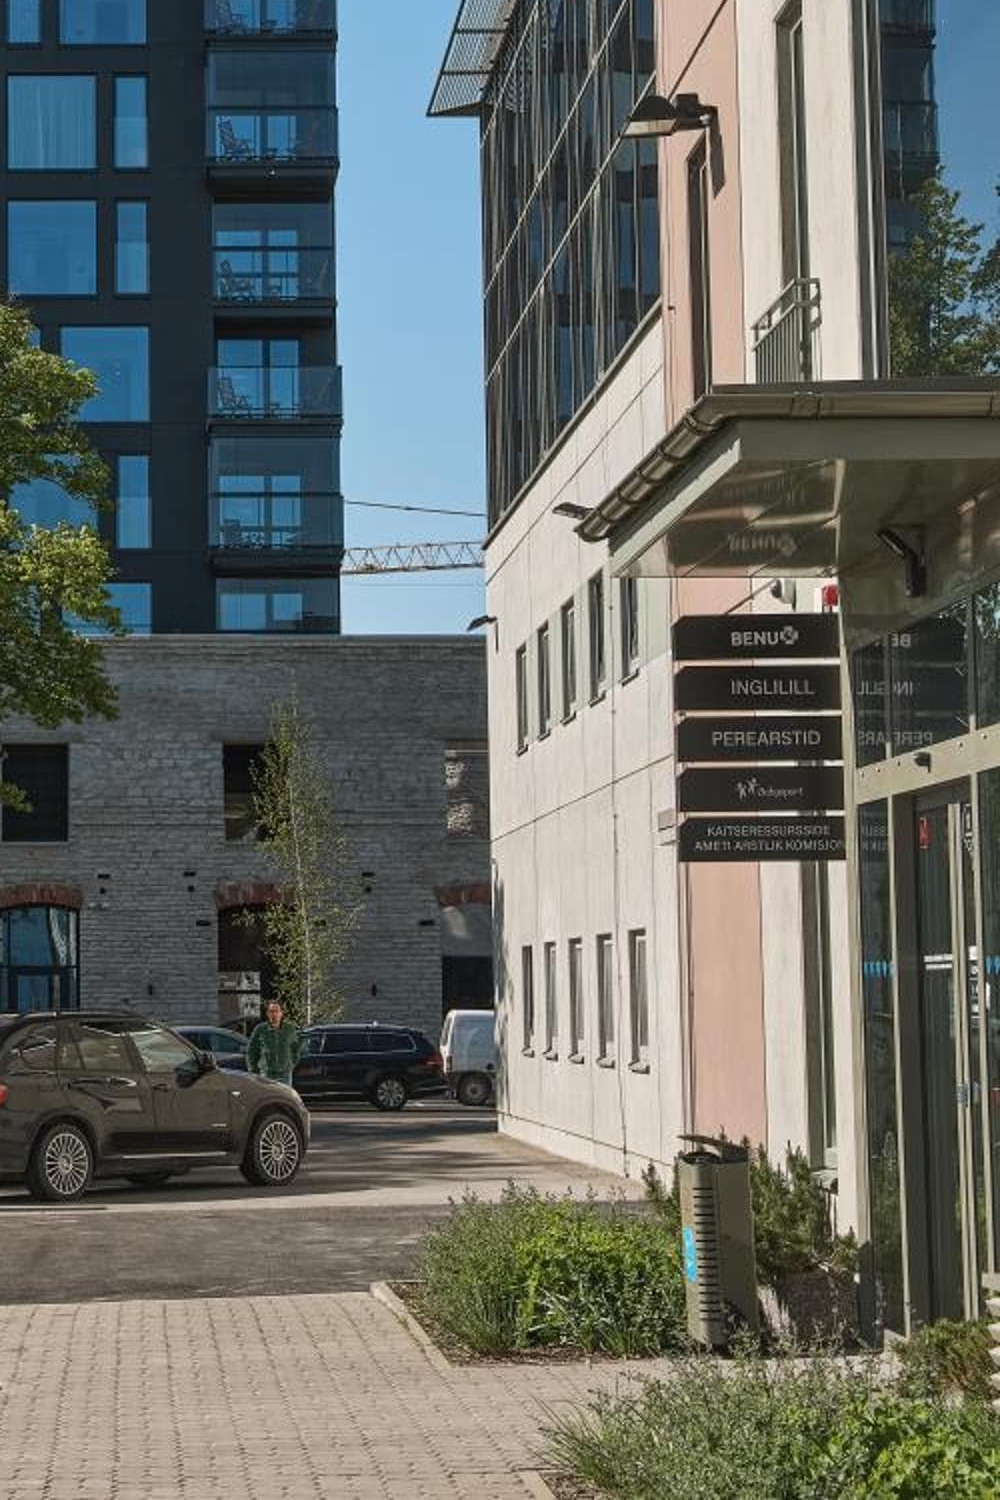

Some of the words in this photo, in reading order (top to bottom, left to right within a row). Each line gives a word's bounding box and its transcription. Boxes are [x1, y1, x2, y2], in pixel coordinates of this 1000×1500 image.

[730, 631, 779, 647] BENU
[730, 679, 815, 696] INGLILILL
[711, 730, 821, 748] PEREARSTID
